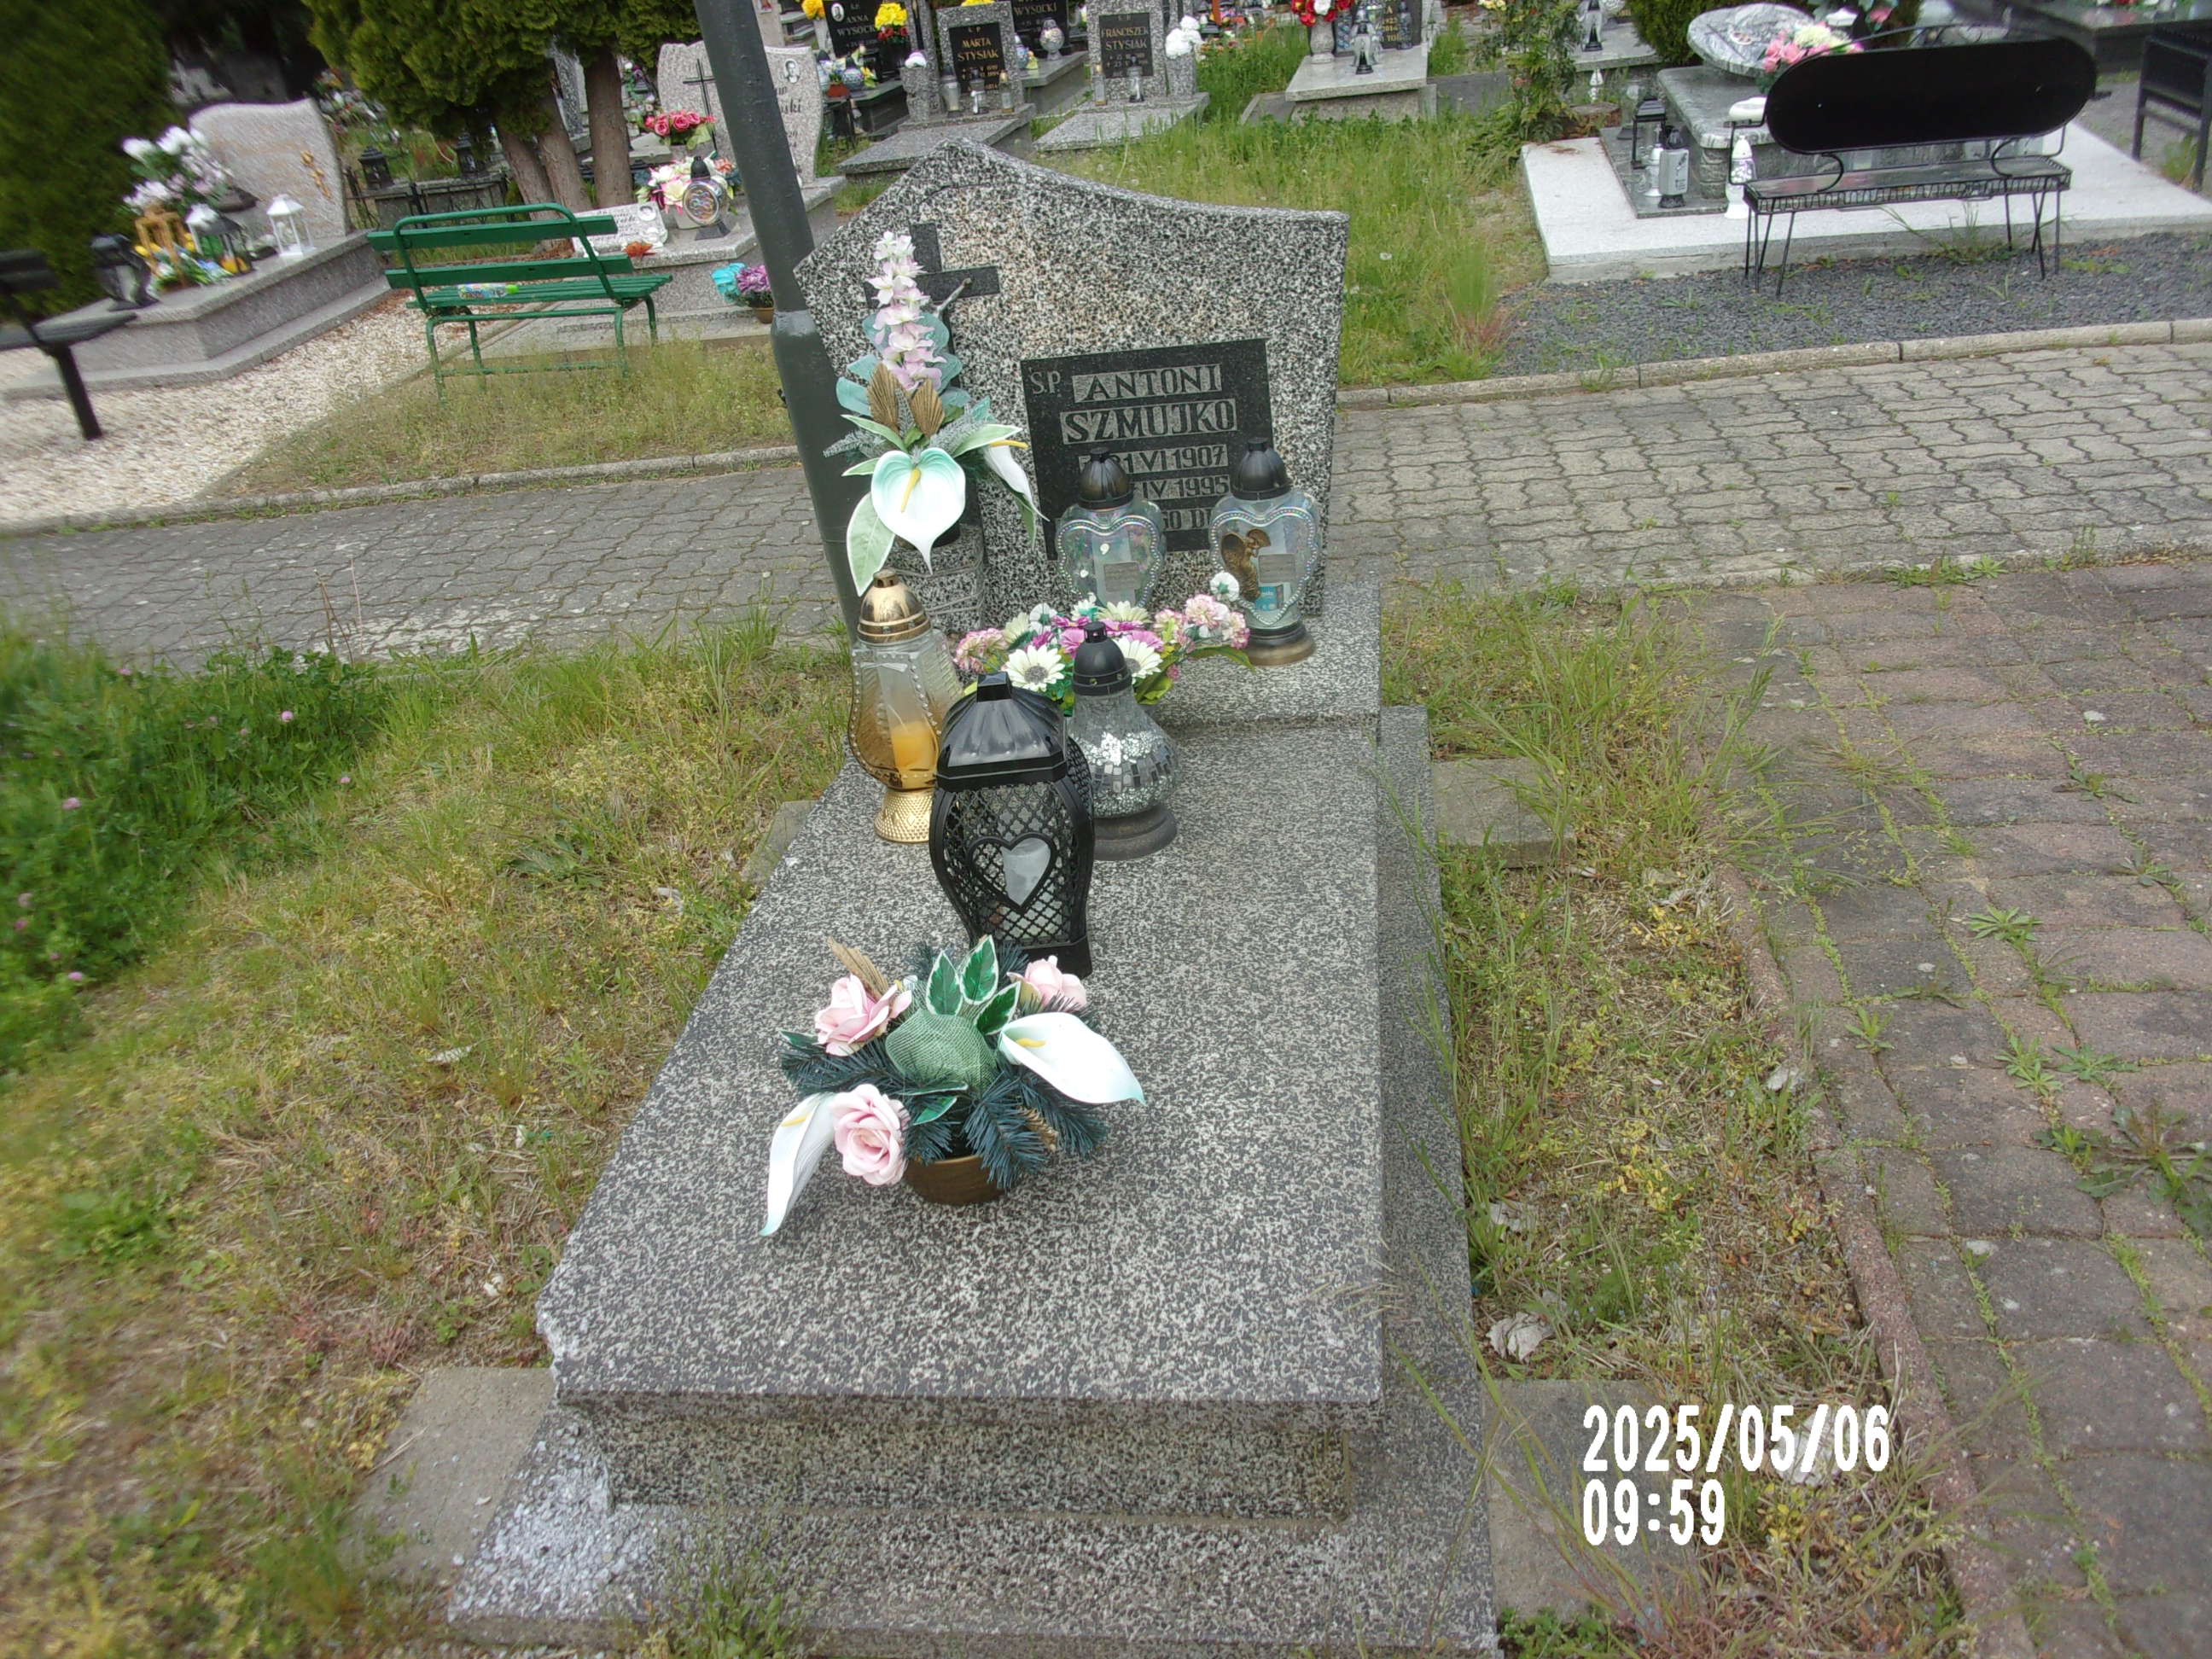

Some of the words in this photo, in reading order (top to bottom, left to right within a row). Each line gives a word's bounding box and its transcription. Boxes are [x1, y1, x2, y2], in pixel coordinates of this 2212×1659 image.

[847, 15, 869, 23] ANNA
[837, 25, 876, 36] WYSOCK
[963, 37, 992, 48] MARTA
[1105, 38, 1147, 51] STYSIAK
[958, 49, 998, 61] STYSIAK
[1083, 365, 1219, 401] ANTONI
[1064, 400, 1235, 442] SZMUJKO
[1139, 449, 1167, 472] VI
[1173, 445, 1225, 469] 1907
[1142, 480, 1167, 499] IV
[1174, 475, 1229, 497] 1995
